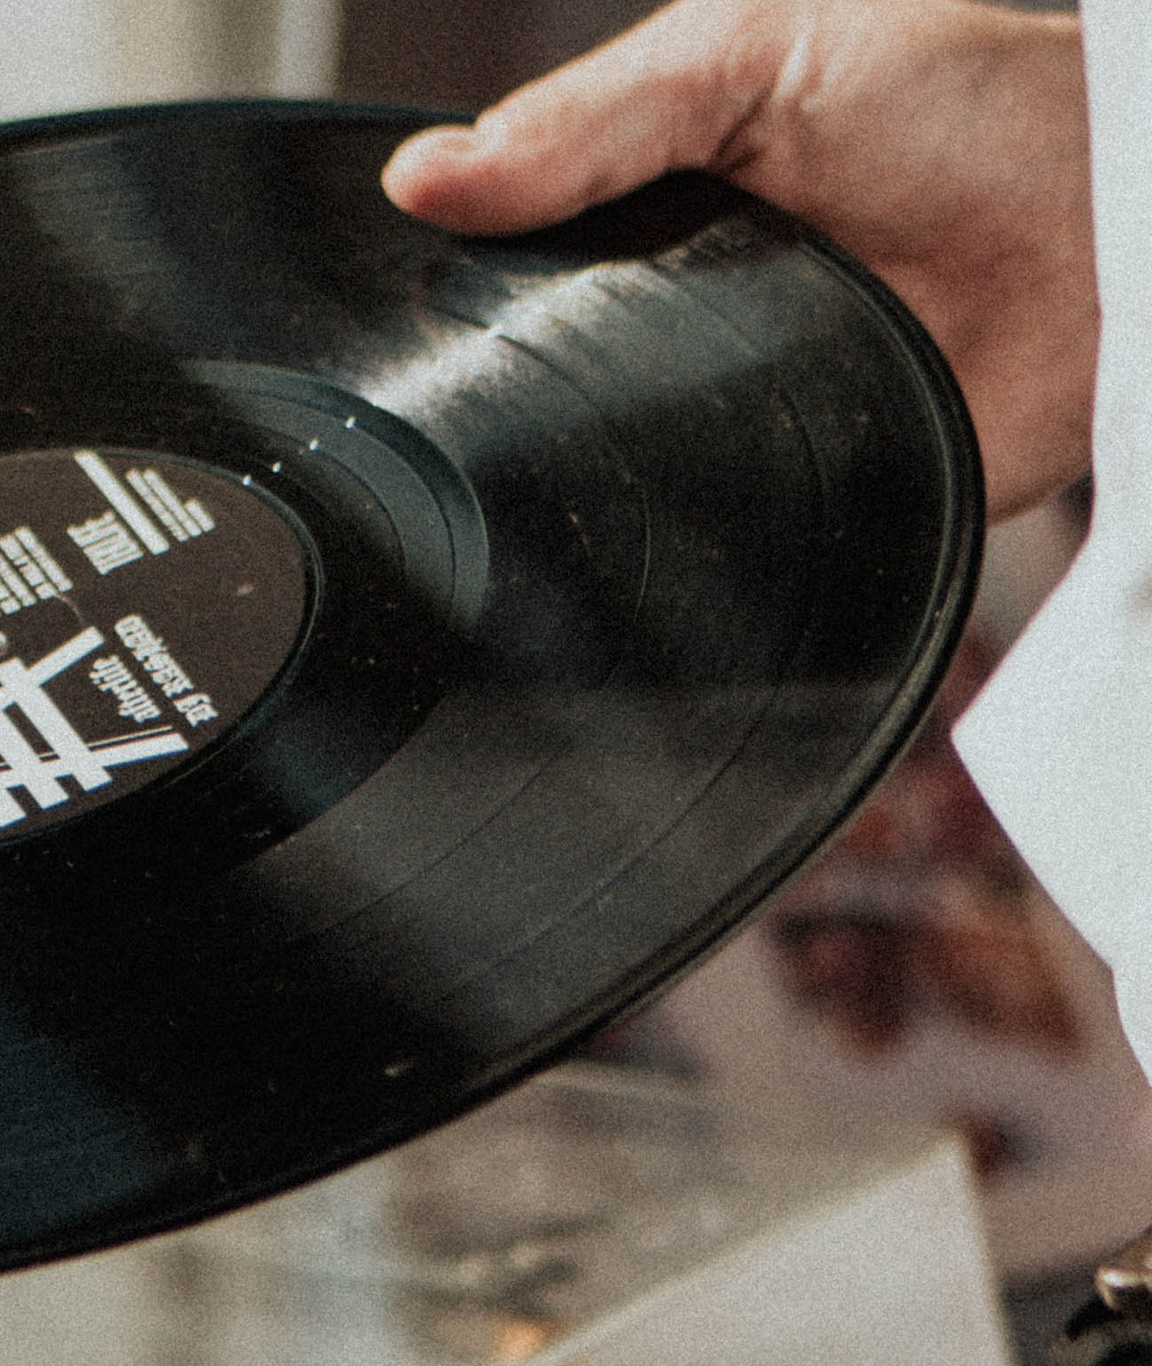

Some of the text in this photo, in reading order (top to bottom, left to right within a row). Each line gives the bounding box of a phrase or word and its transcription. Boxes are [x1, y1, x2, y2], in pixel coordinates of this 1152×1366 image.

[89, 655, 162, 723] afterlife
[114, 614, 193, 697] RASHAD
[173, 693, 218, 727] DJ
